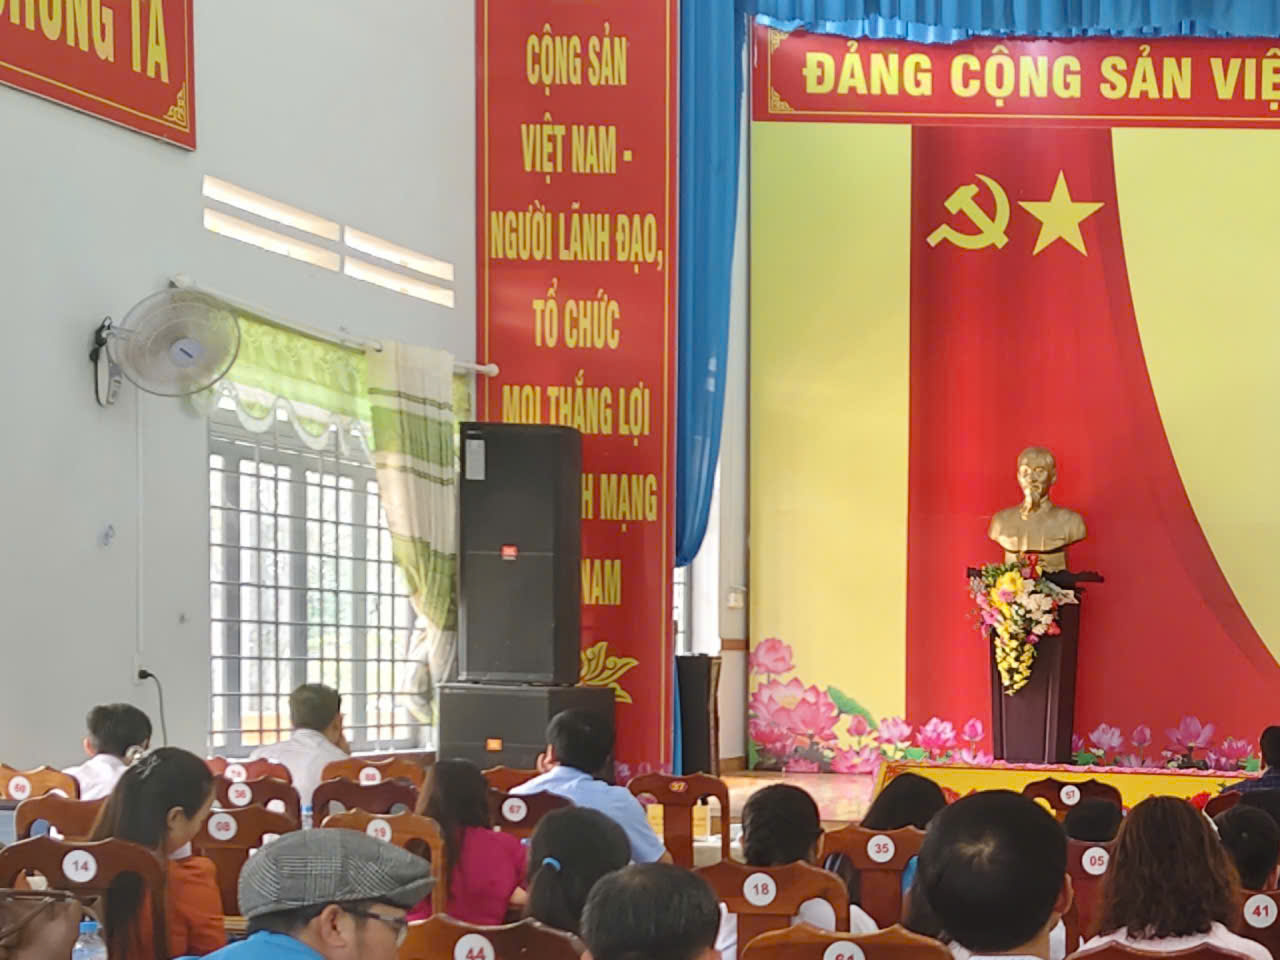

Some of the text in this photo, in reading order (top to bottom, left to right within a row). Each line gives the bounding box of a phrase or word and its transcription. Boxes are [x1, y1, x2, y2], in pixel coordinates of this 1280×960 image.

[526, 21, 628, 97] CỘNG SẢN
[802, 39, 933, 96] ĐẢNG
[950, 44, 1081, 107] CỘNG
[1099, 44, 1192, 99] SẢN
[520, 111, 567, 184] VIỆT
[571, 124, 617, 174] NAM
[490, 199, 664, 275] NGƯỜI LÃNH ĐẠO,
[532, 276, 621, 350] TỔ CHỨC
[547, 368, 612, 436] THẮNG
[619, 381, 650, 447] LỢI
[601, 474, 658, 532] MẠNG
[71, 861, 89, 872] 14
[874, 842, 889, 855] 35
[1089, 855, 1105, 868] 05
[753, 883, 770, 896] 18
[1252, 904, 1270, 918] 41
